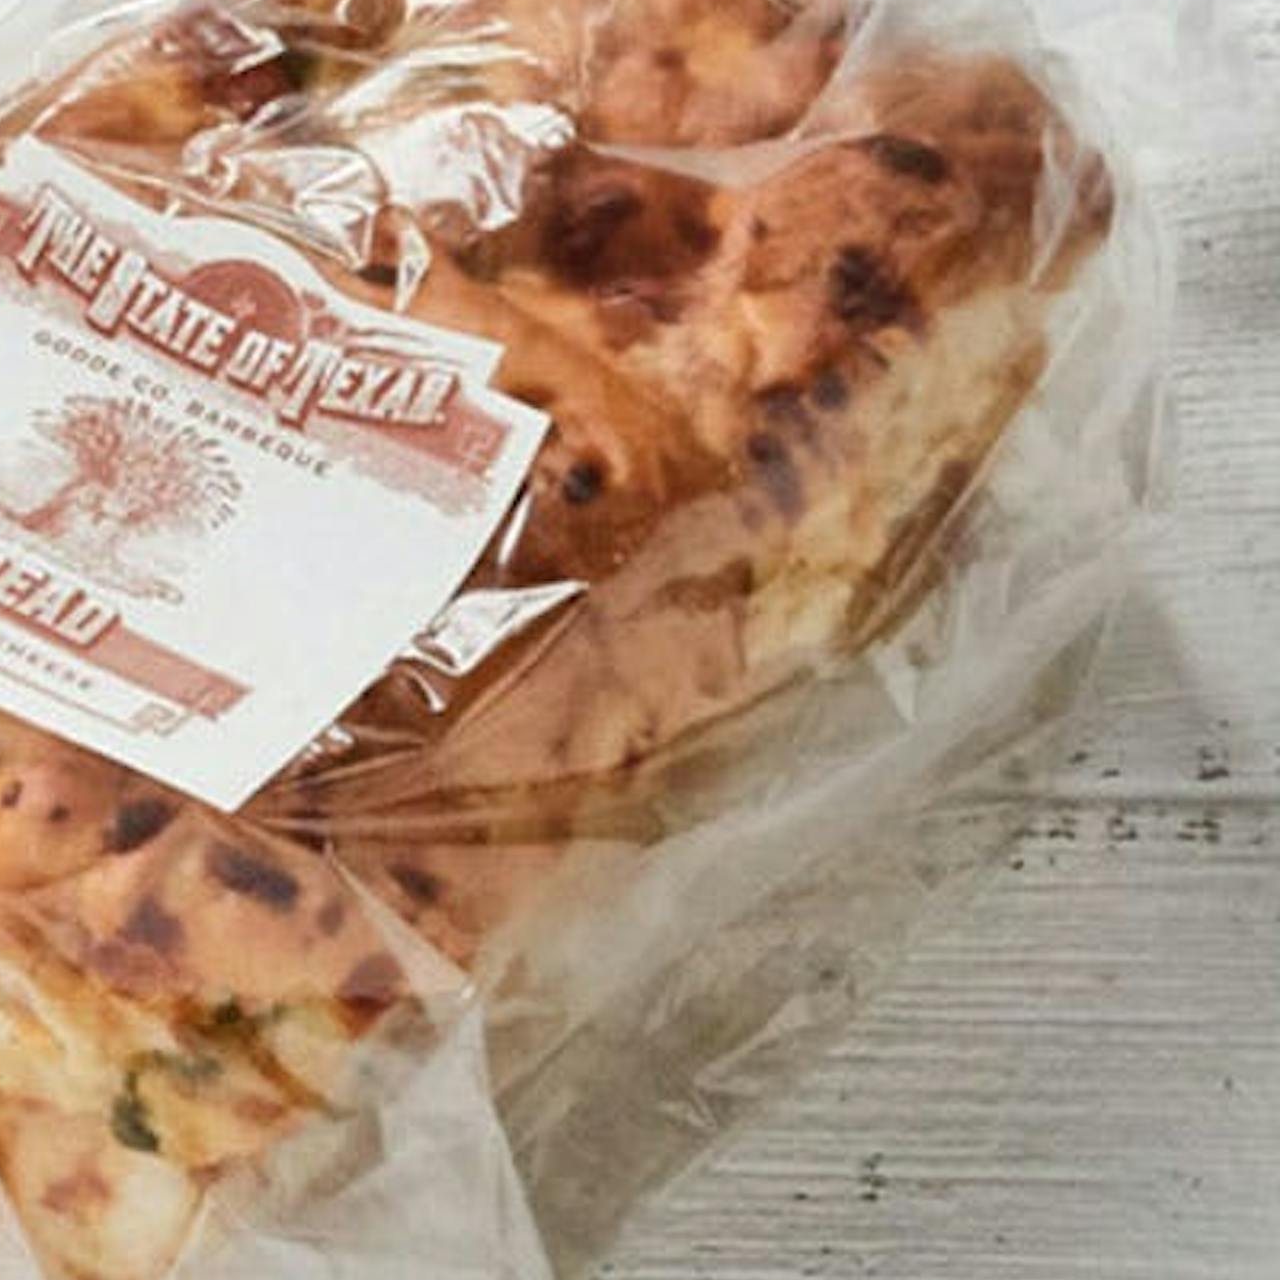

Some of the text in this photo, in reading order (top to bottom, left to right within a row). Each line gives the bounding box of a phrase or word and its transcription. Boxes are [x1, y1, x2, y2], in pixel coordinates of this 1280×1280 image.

[15, 186, 116, 294] THE
[86, 251, 236, 376] STATE
[225, 331, 297, 394] OF
[34, 327, 123, 379] GOODE
[186, 399, 335, 478] BARBEQUE
